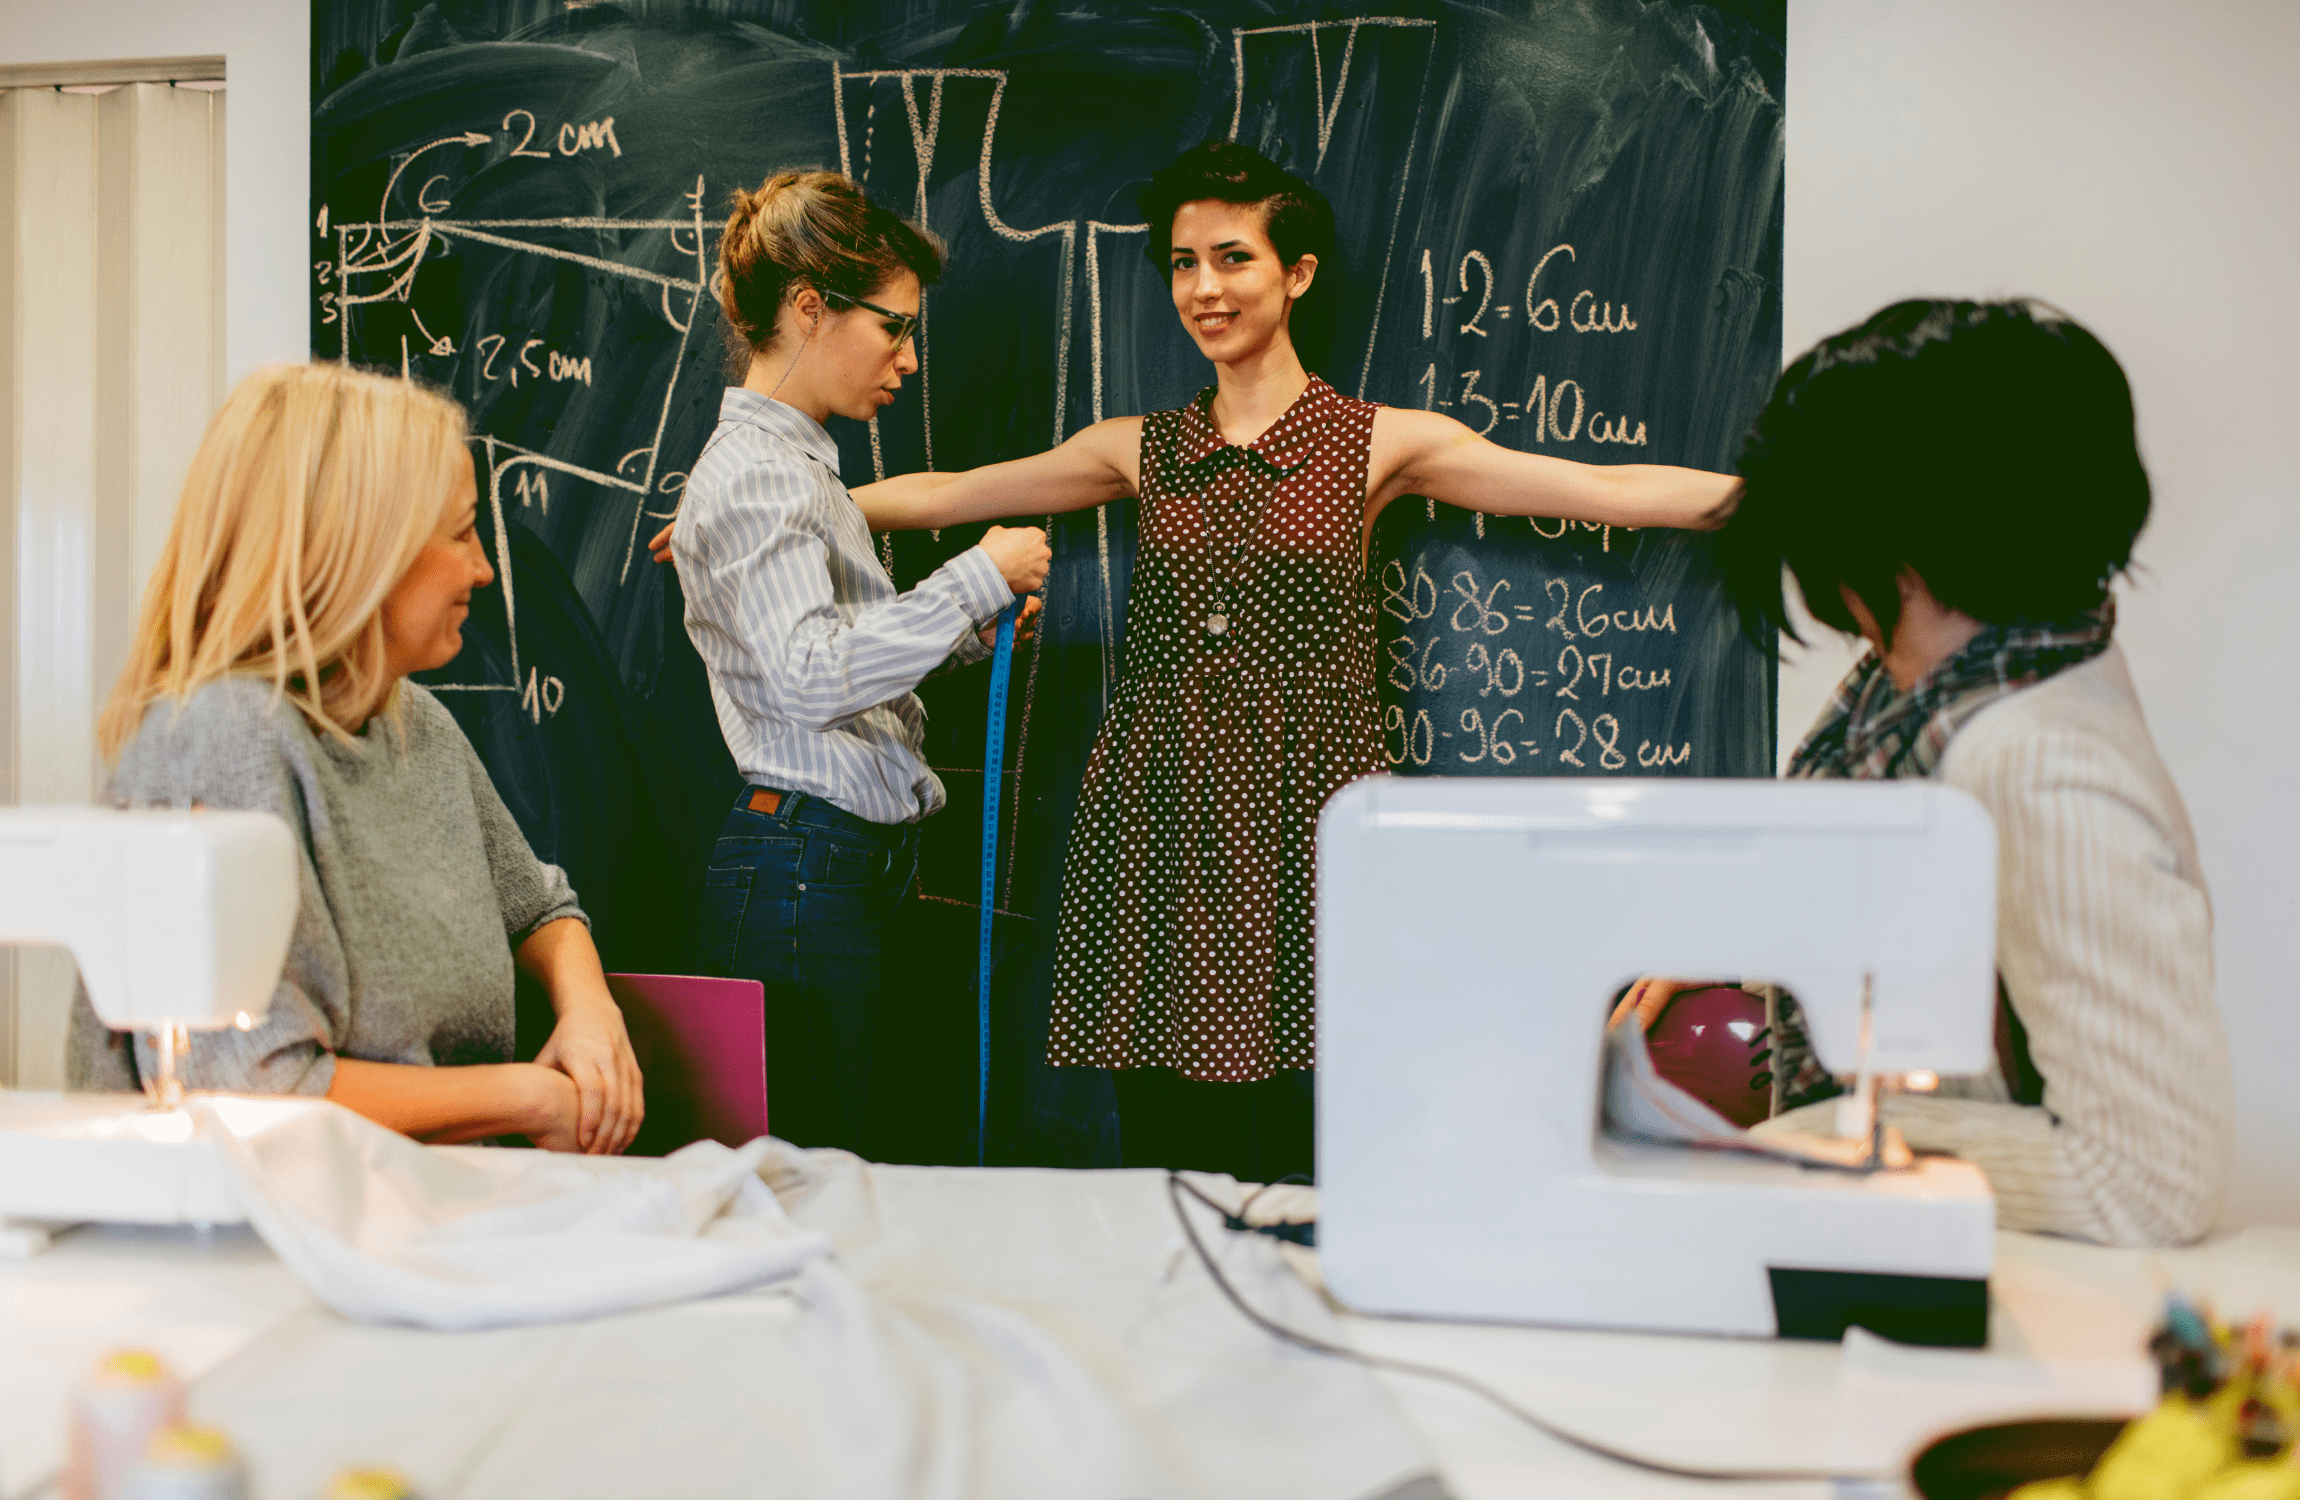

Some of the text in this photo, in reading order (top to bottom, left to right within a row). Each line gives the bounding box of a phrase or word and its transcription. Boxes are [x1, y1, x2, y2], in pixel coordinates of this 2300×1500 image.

[316, 202, 330, 239] 1
[313, 260, 333, 286] 2
[318, 291, 338, 325] 3
[513, 469, 550, 517] 11
[521, 665, 566, 726] 10
